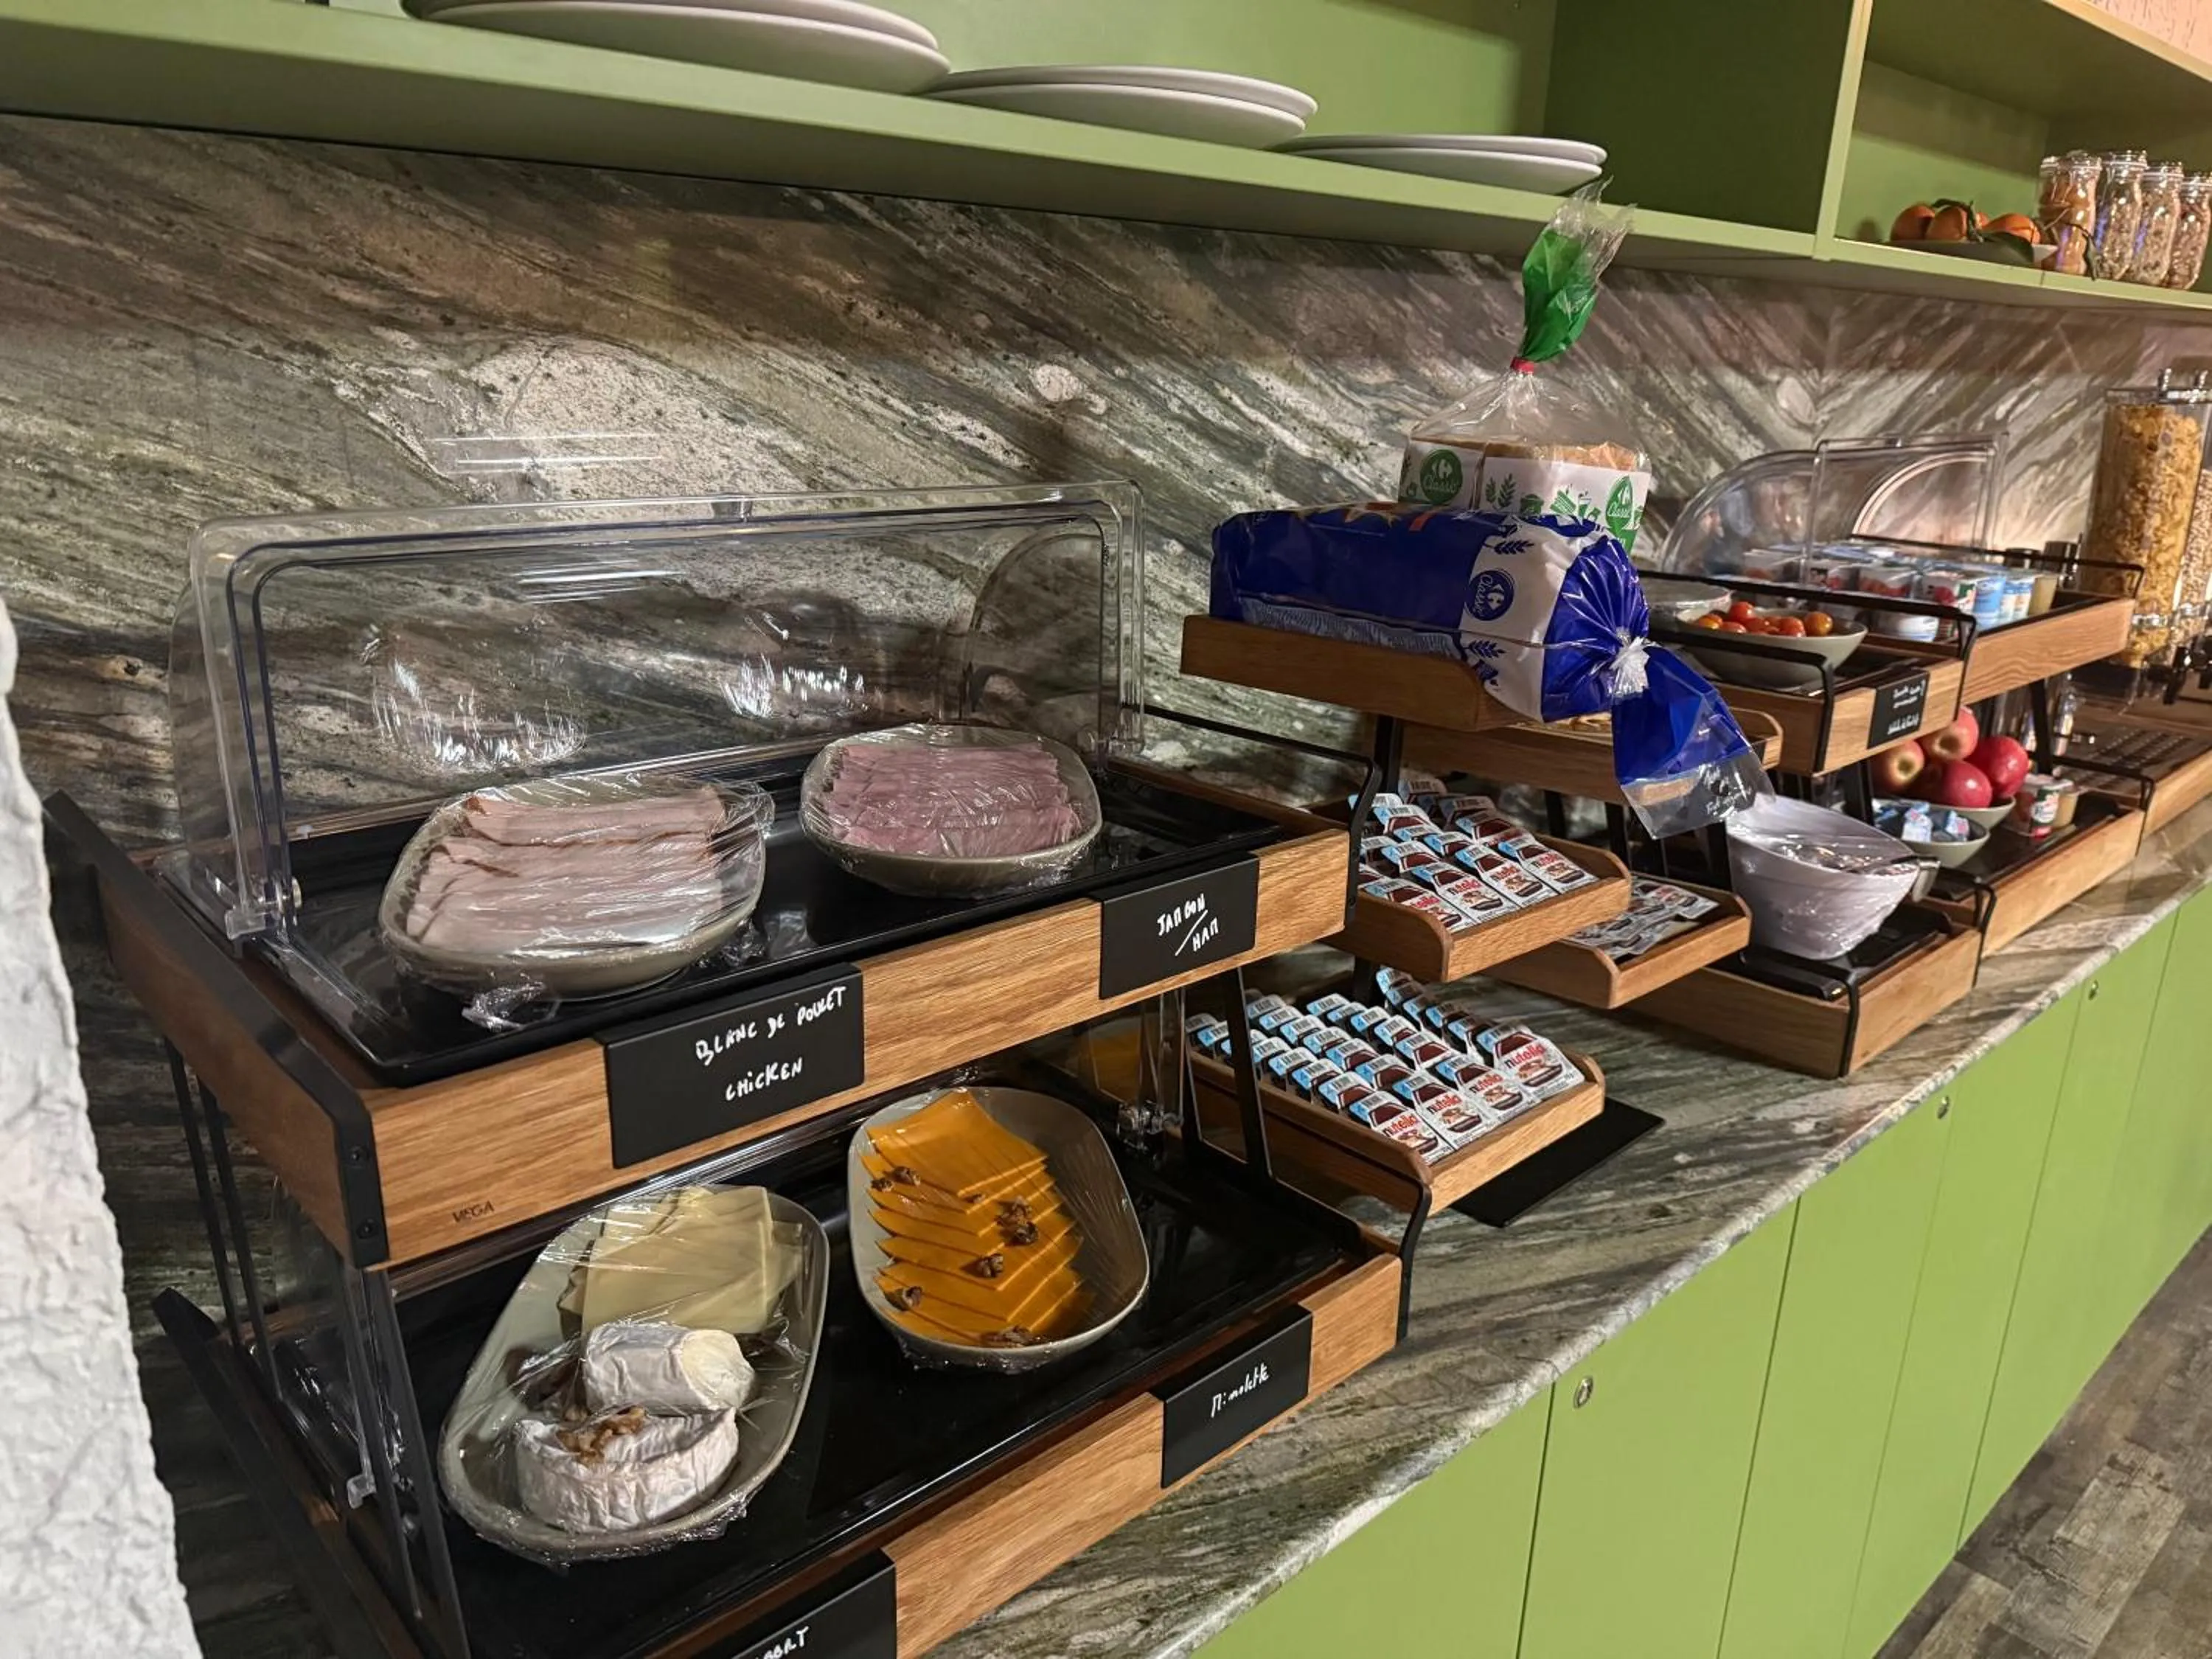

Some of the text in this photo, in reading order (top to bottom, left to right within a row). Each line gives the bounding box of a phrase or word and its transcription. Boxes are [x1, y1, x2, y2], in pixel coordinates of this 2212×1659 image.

[1157, 893, 1206, 936] JAMBON
[695, 985, 847, 1066] BLANC DE POULET
[1504, 1043, 1546, 1069] nutella
[1469, 1072, 1504, 1093] nutella
[1427, 1093, 1463, 1115] nutella
[1382, 1113, 1417, 1137] nutella
